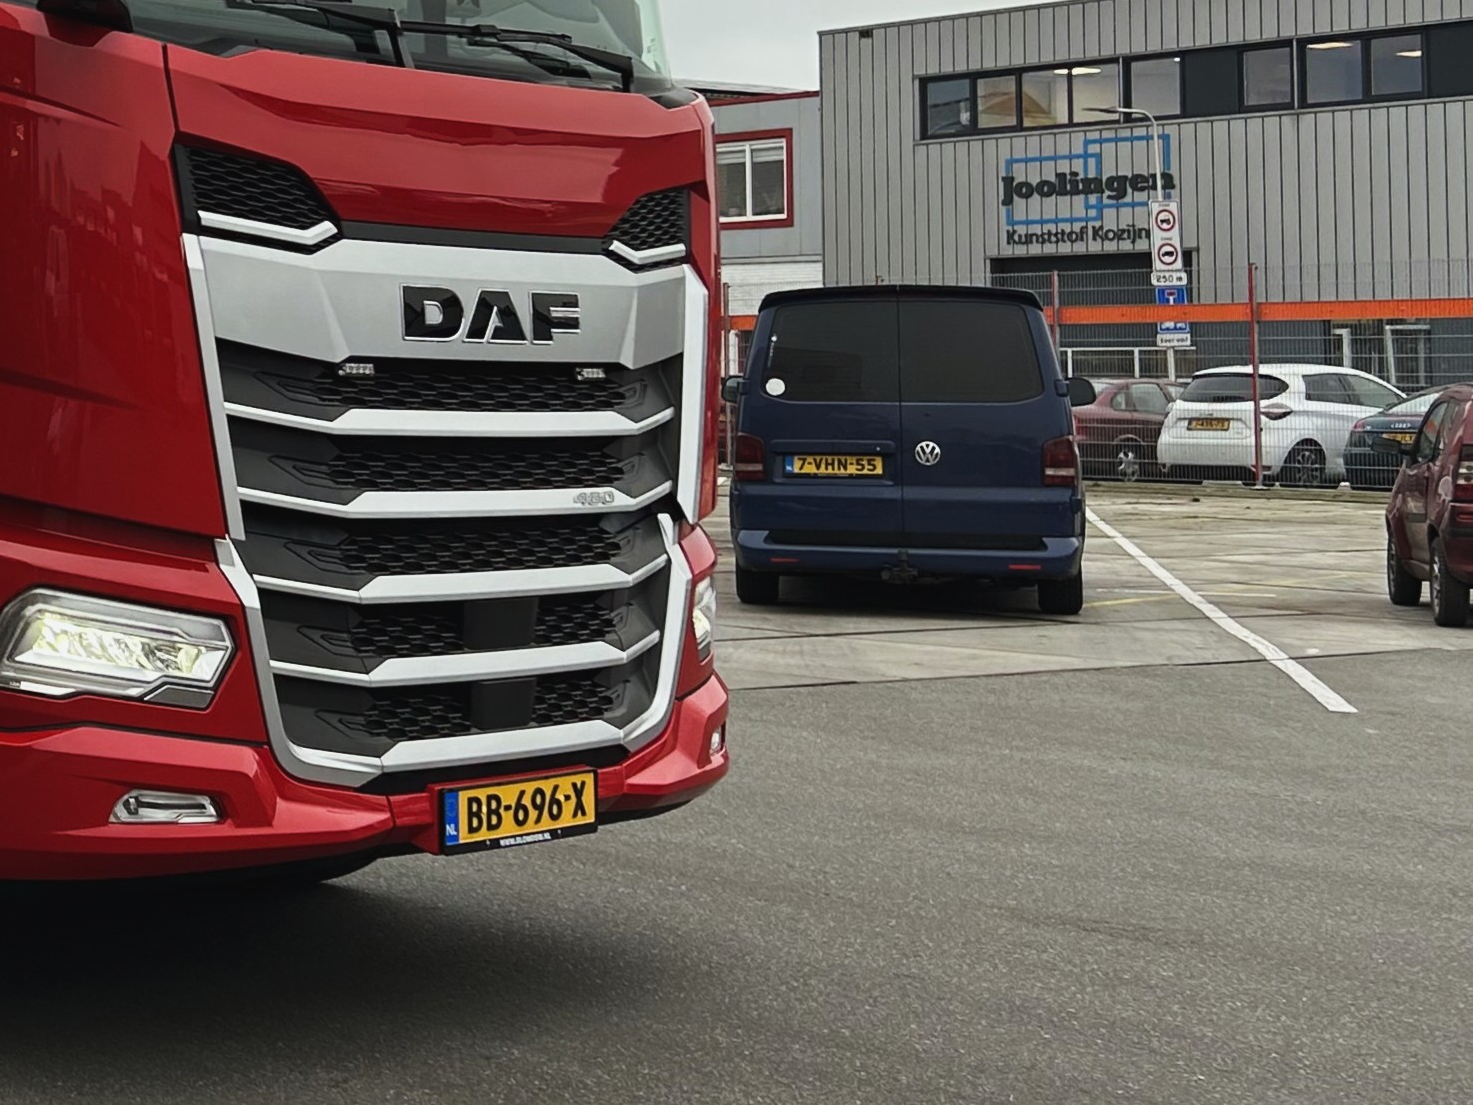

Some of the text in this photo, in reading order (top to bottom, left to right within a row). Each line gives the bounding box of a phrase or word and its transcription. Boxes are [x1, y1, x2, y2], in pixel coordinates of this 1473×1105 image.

[1001, 171, 1176, 206] Joolingen
[1006, 223, 1151, 246] Kunststof Kozijn
[399, 283, 581, 345] DAF
[797, 456, 877, 472] 7-VHN-55
[446, 780, 587, 836] NL BB-696-X
